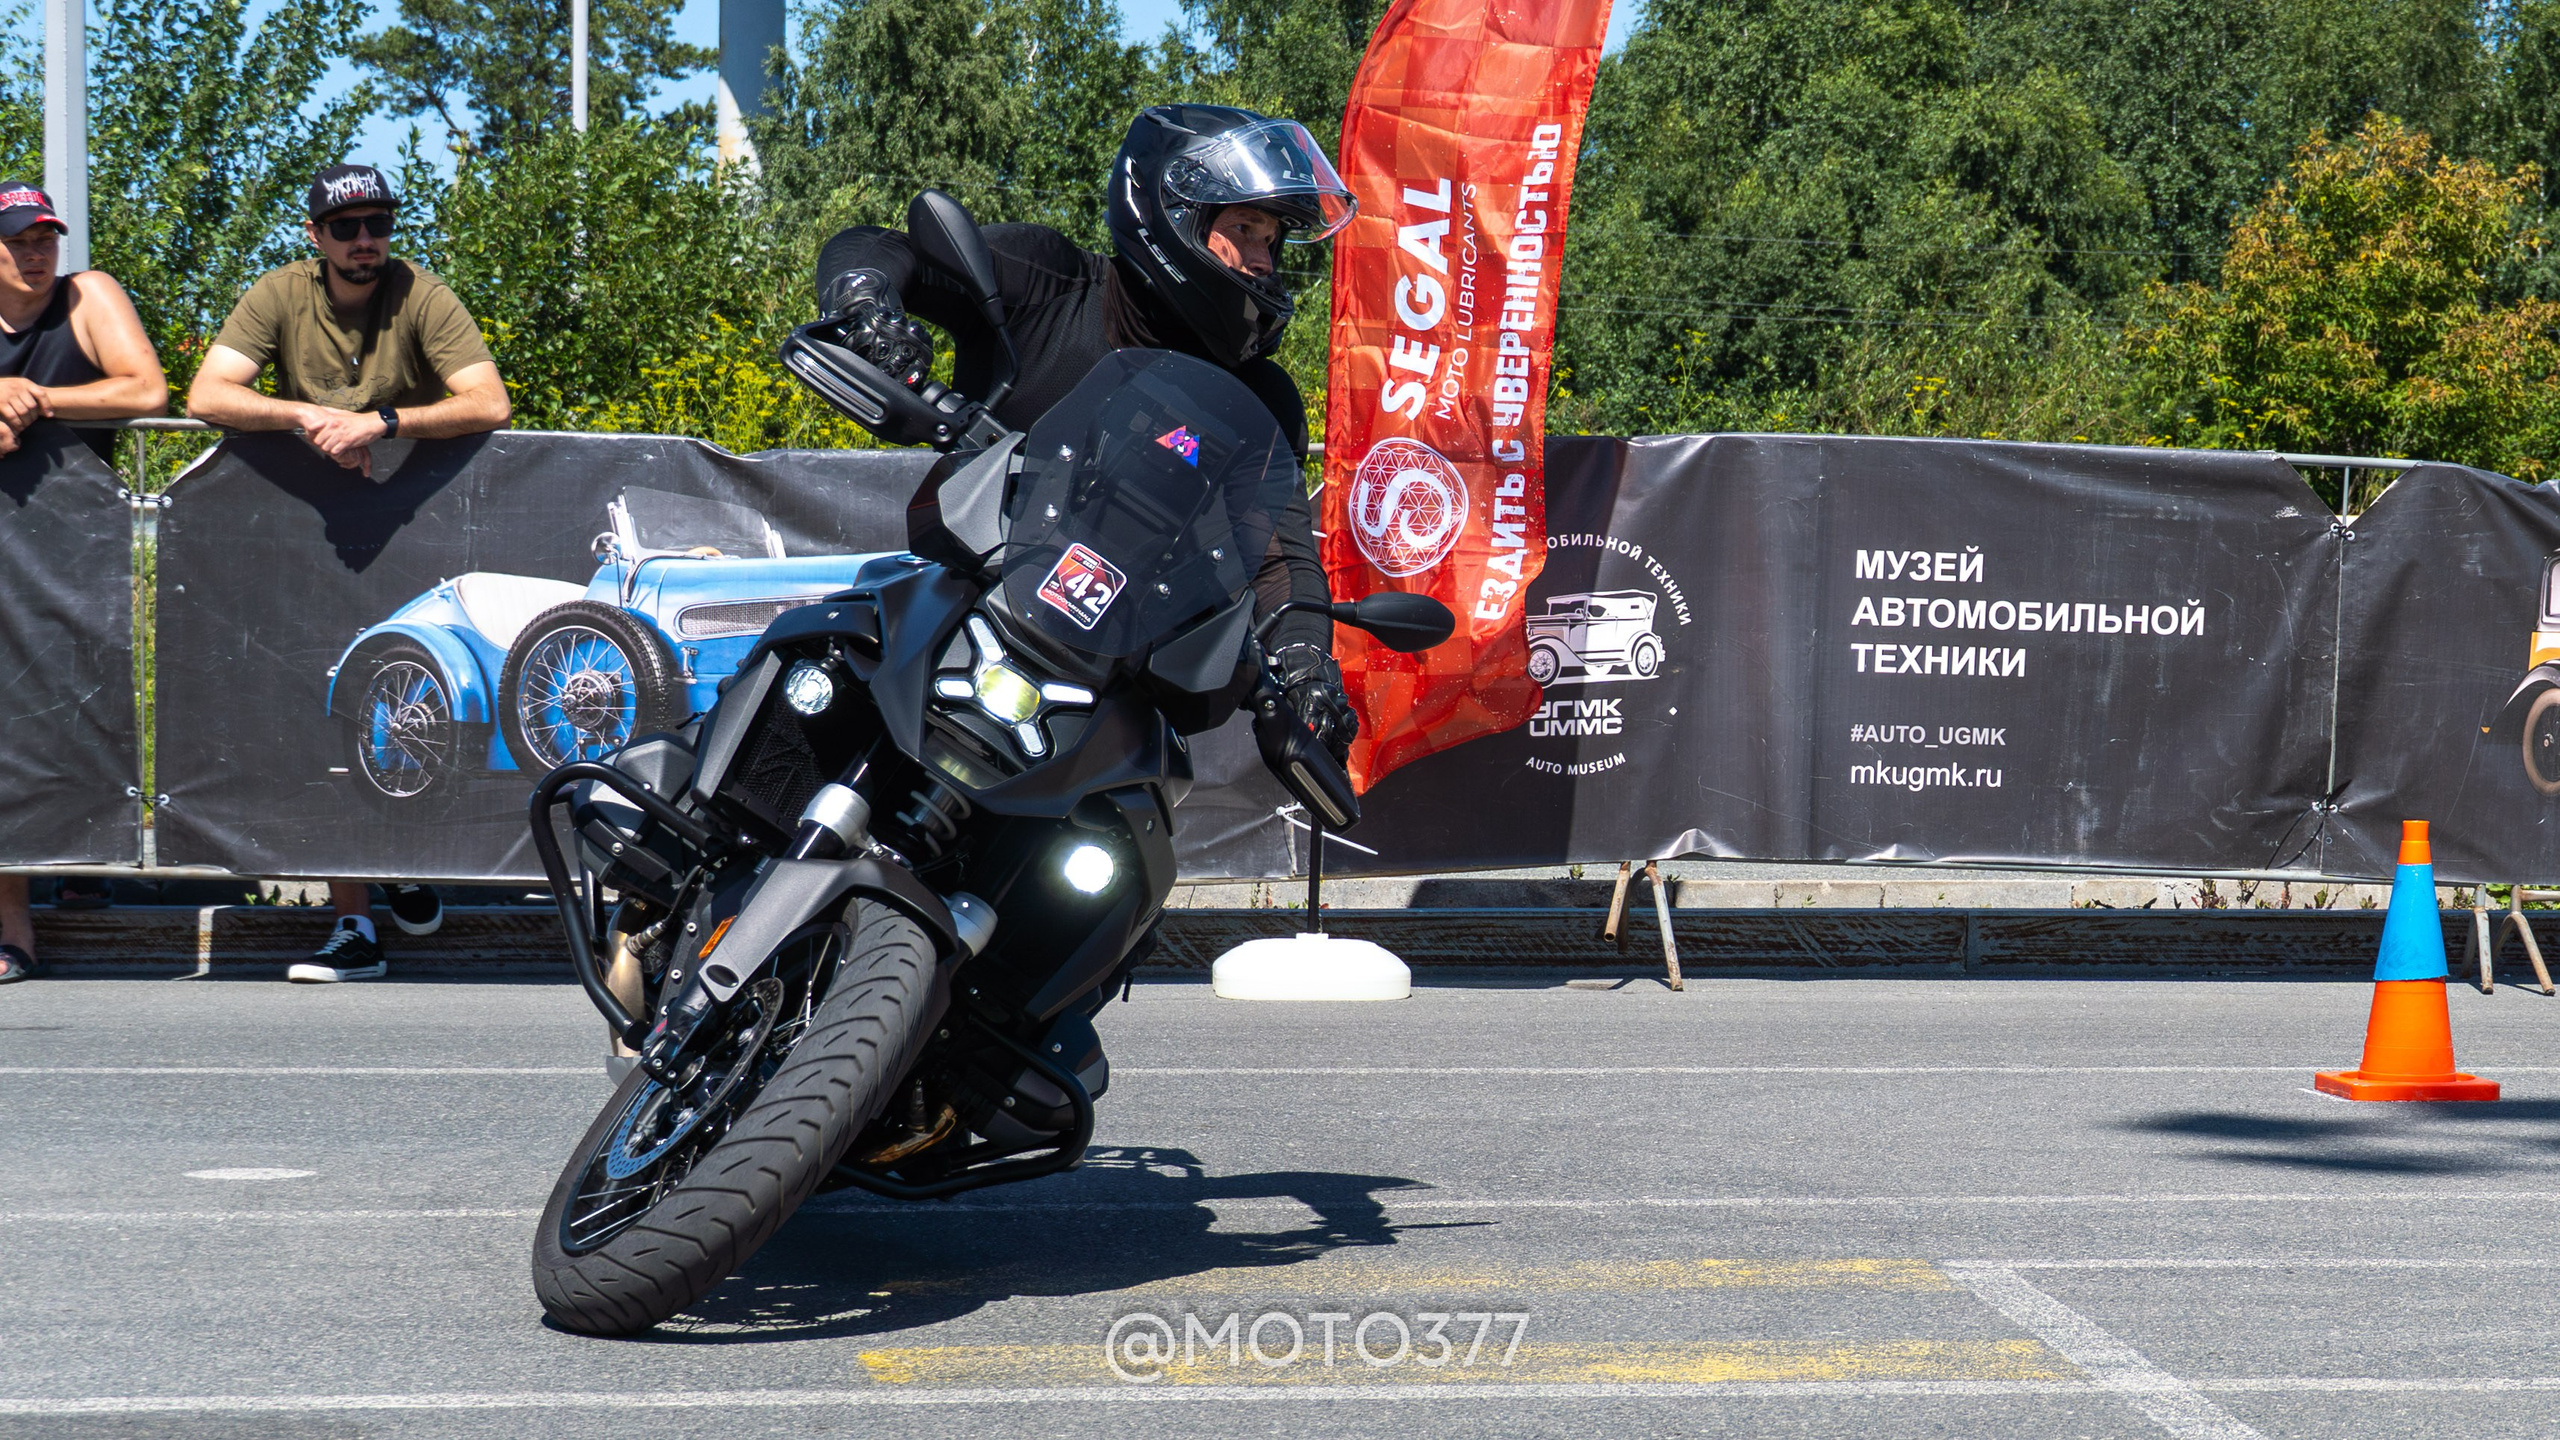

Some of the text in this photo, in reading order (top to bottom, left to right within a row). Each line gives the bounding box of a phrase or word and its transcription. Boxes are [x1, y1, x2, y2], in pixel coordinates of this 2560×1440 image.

[1137, 228, 1187, 284] LS2
[1381, 177, 1452, 420] SEGAL
[1435, 182, 1477, 420] MOTO LUBRICANTS
[1474, 123, 1562, 620] ЕЗДИТЬ С УВЕРЕННОСТЬЮ
[1547, 533, 1692, 626] ОБИЛЬНОЙ ТЕХНИКИ
[1855, 545, 1985, 583] МУЗЕЙ
[1065, 572, 1112, 615] 42
[1851, 597, 2206, 637] АВТОМОБИЛЬНОЙ
[1851, 643, 2027, 678] ТЕХНИКИ
[1529, 717, 1623, 737] UMMC
[1850, 724, 2007, 749] #AUTO_UGMK
[1525, 752, 1626, 775] AUTO MUSEUM
[1850, 760, 2003, 792] mkugmk.ru
